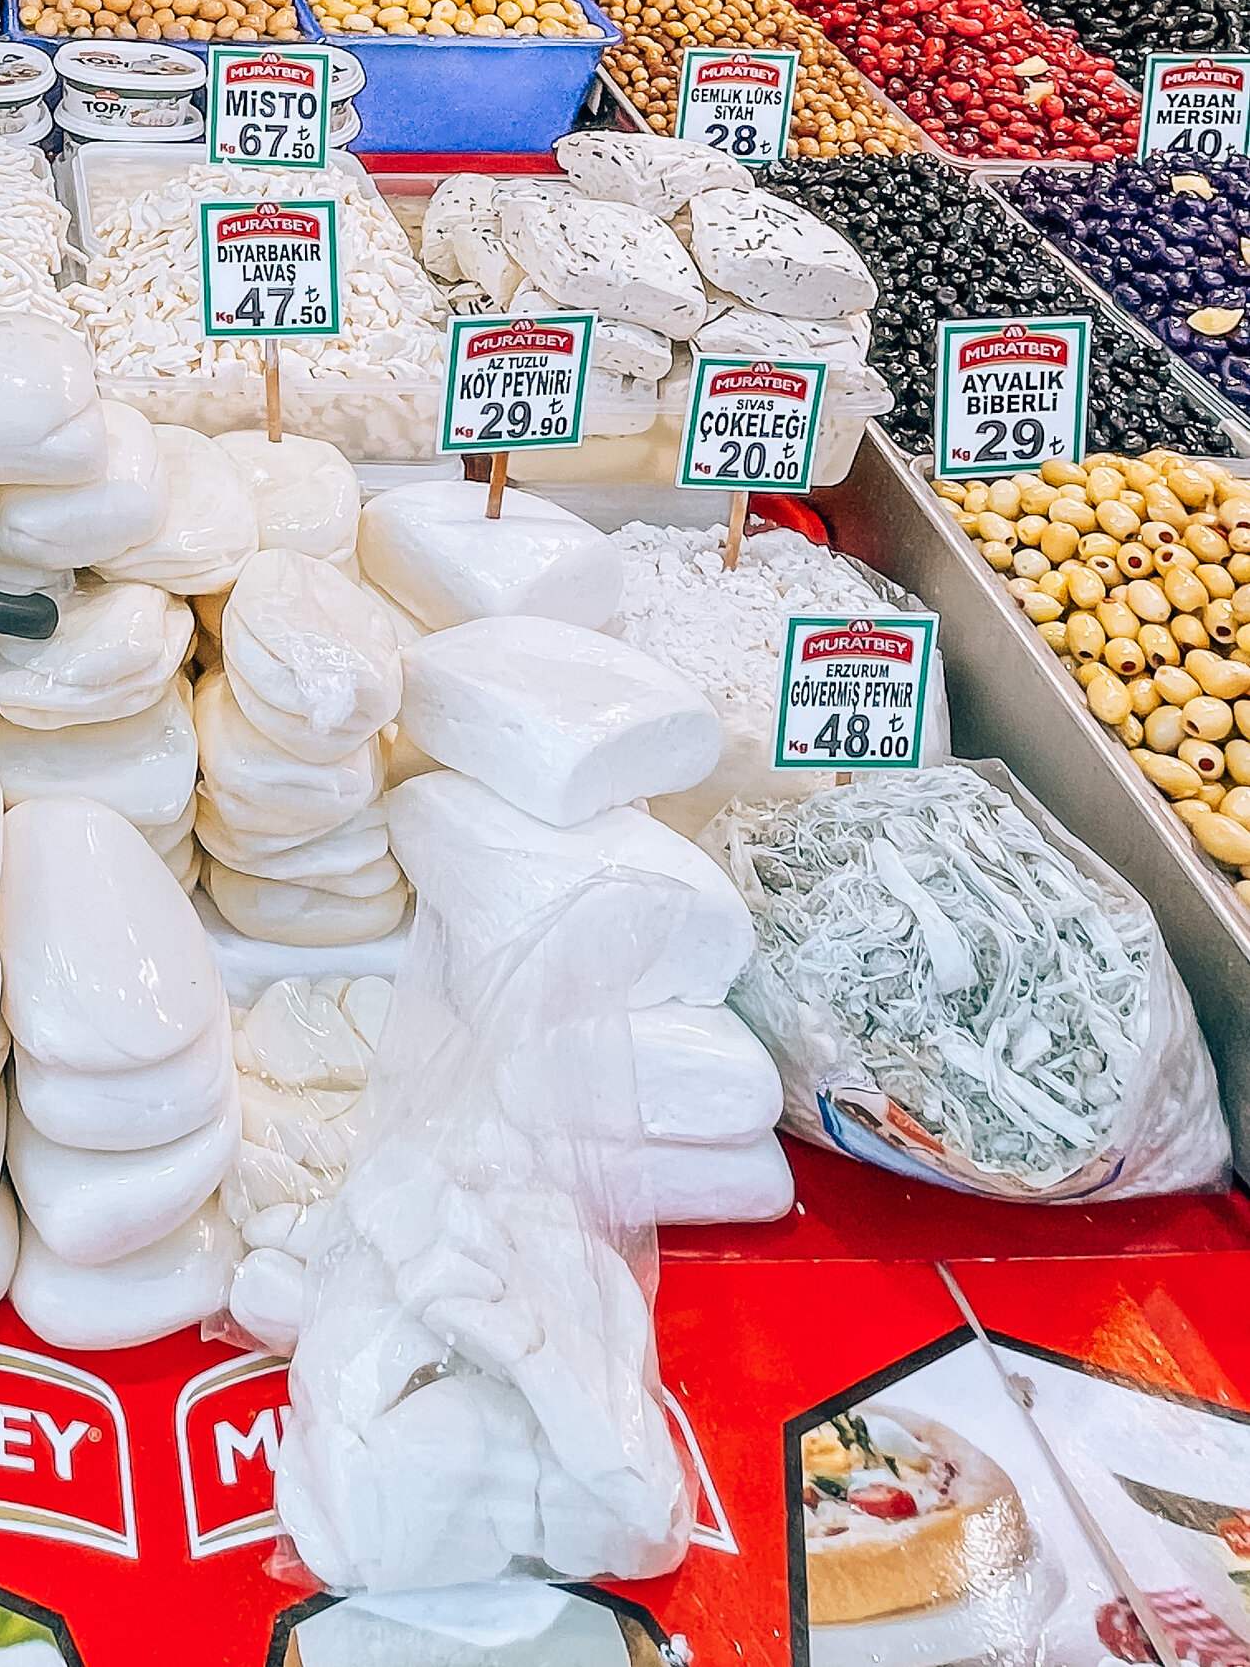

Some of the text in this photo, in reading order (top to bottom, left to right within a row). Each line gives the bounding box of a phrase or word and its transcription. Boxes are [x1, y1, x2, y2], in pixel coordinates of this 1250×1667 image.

[230, 66, 309, 81] MURATBEY
[701, 66, 776, 81] MURATBEY
[1165, 71, 1240, 85] MURATBEY
[746, 87, 782, 105] LÜKS
[1166, 94, 1236, 108] YABAN
[220, 123, 315, 159] Kg 67.50
[705, 124, 757, 156] 28
[1167, 128, 1222, 159] 40
[222, 218, 314, 235] MURATBEY
[243, 264, 296, 286] LAVAŞ
[215, 287, 327, 326] Kg 47.50
[473, 334, 569, 352] MURATBEY
[965, 341, 1062, 362] MURATBEY
[487, 356, 548, 370] AZ TUZLU
[460, 367, 497, 400] KÖY
[715, 376, 802, 392] MURATBEY
[962, 370, 1065, 394] AYVALIK
[455, 401, 568, 441] Kg 29.90
[952, 418, 1045, 463] Kg 29
[695, 441, 799, 480] Kg 20.00
[808, 637, 908, 655] MURATBEY
[826, 664, 889, 678] ERZURUM
[788, 713, 909, 758] Kg 48.00
